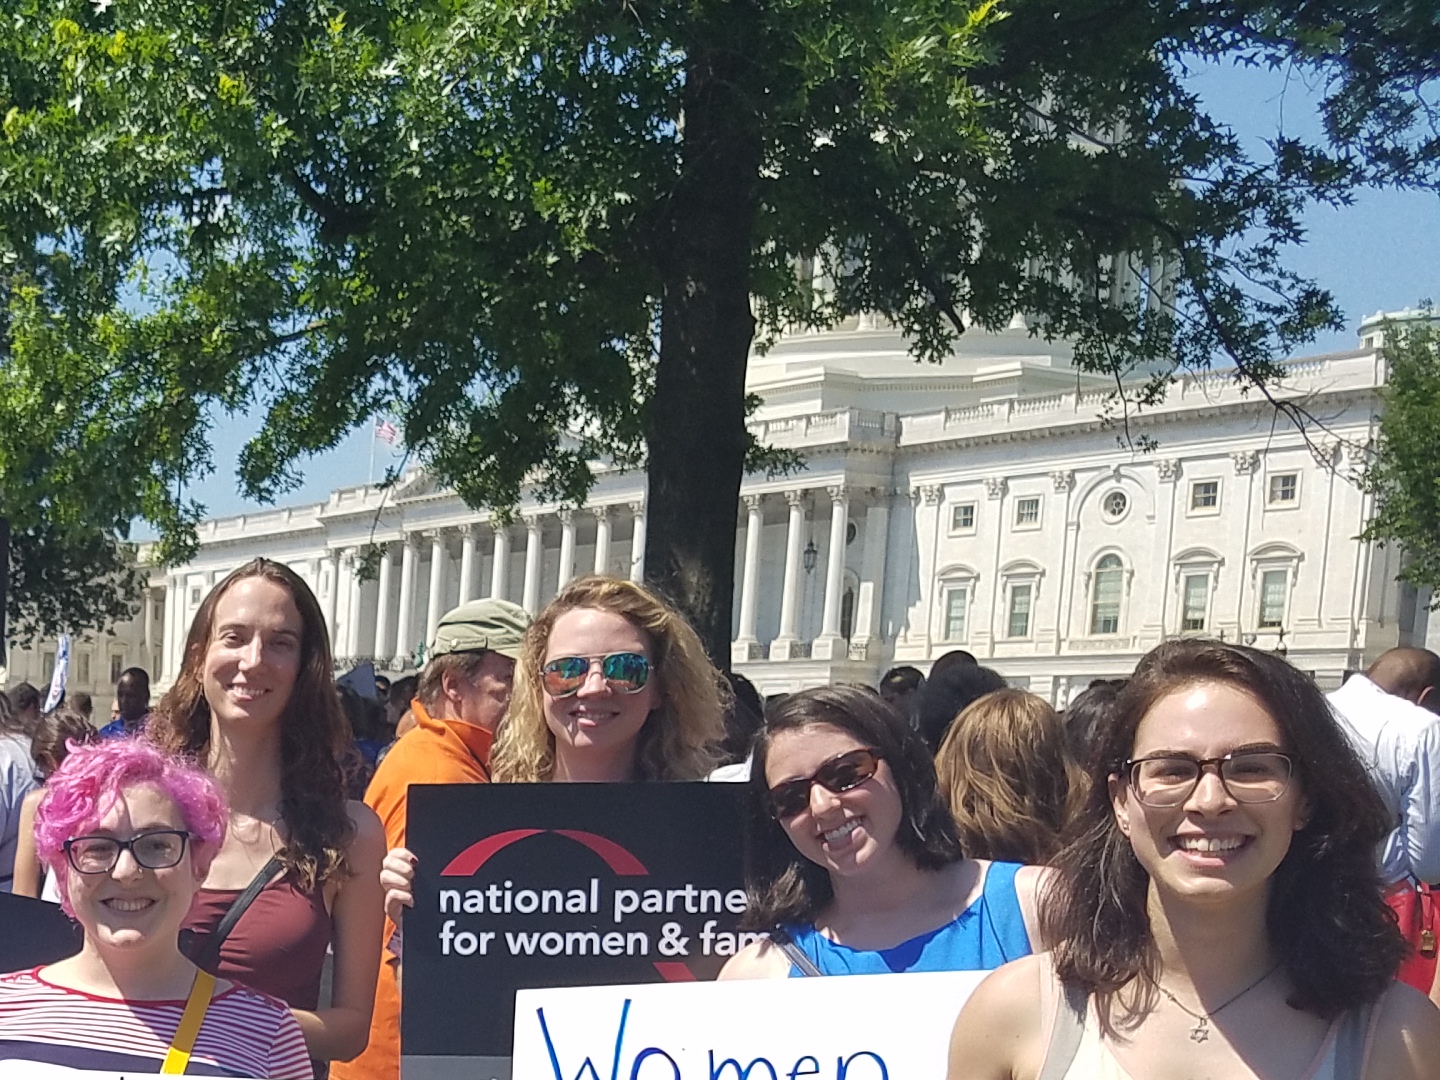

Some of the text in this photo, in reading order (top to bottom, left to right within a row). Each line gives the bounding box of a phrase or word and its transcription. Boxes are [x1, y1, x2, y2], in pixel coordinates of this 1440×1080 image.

[439, 878, 748, 923] national partne
[439, 921, 495, 955] for
[505, 930, 648, 956] women
[658, 921, 689, 956] &
